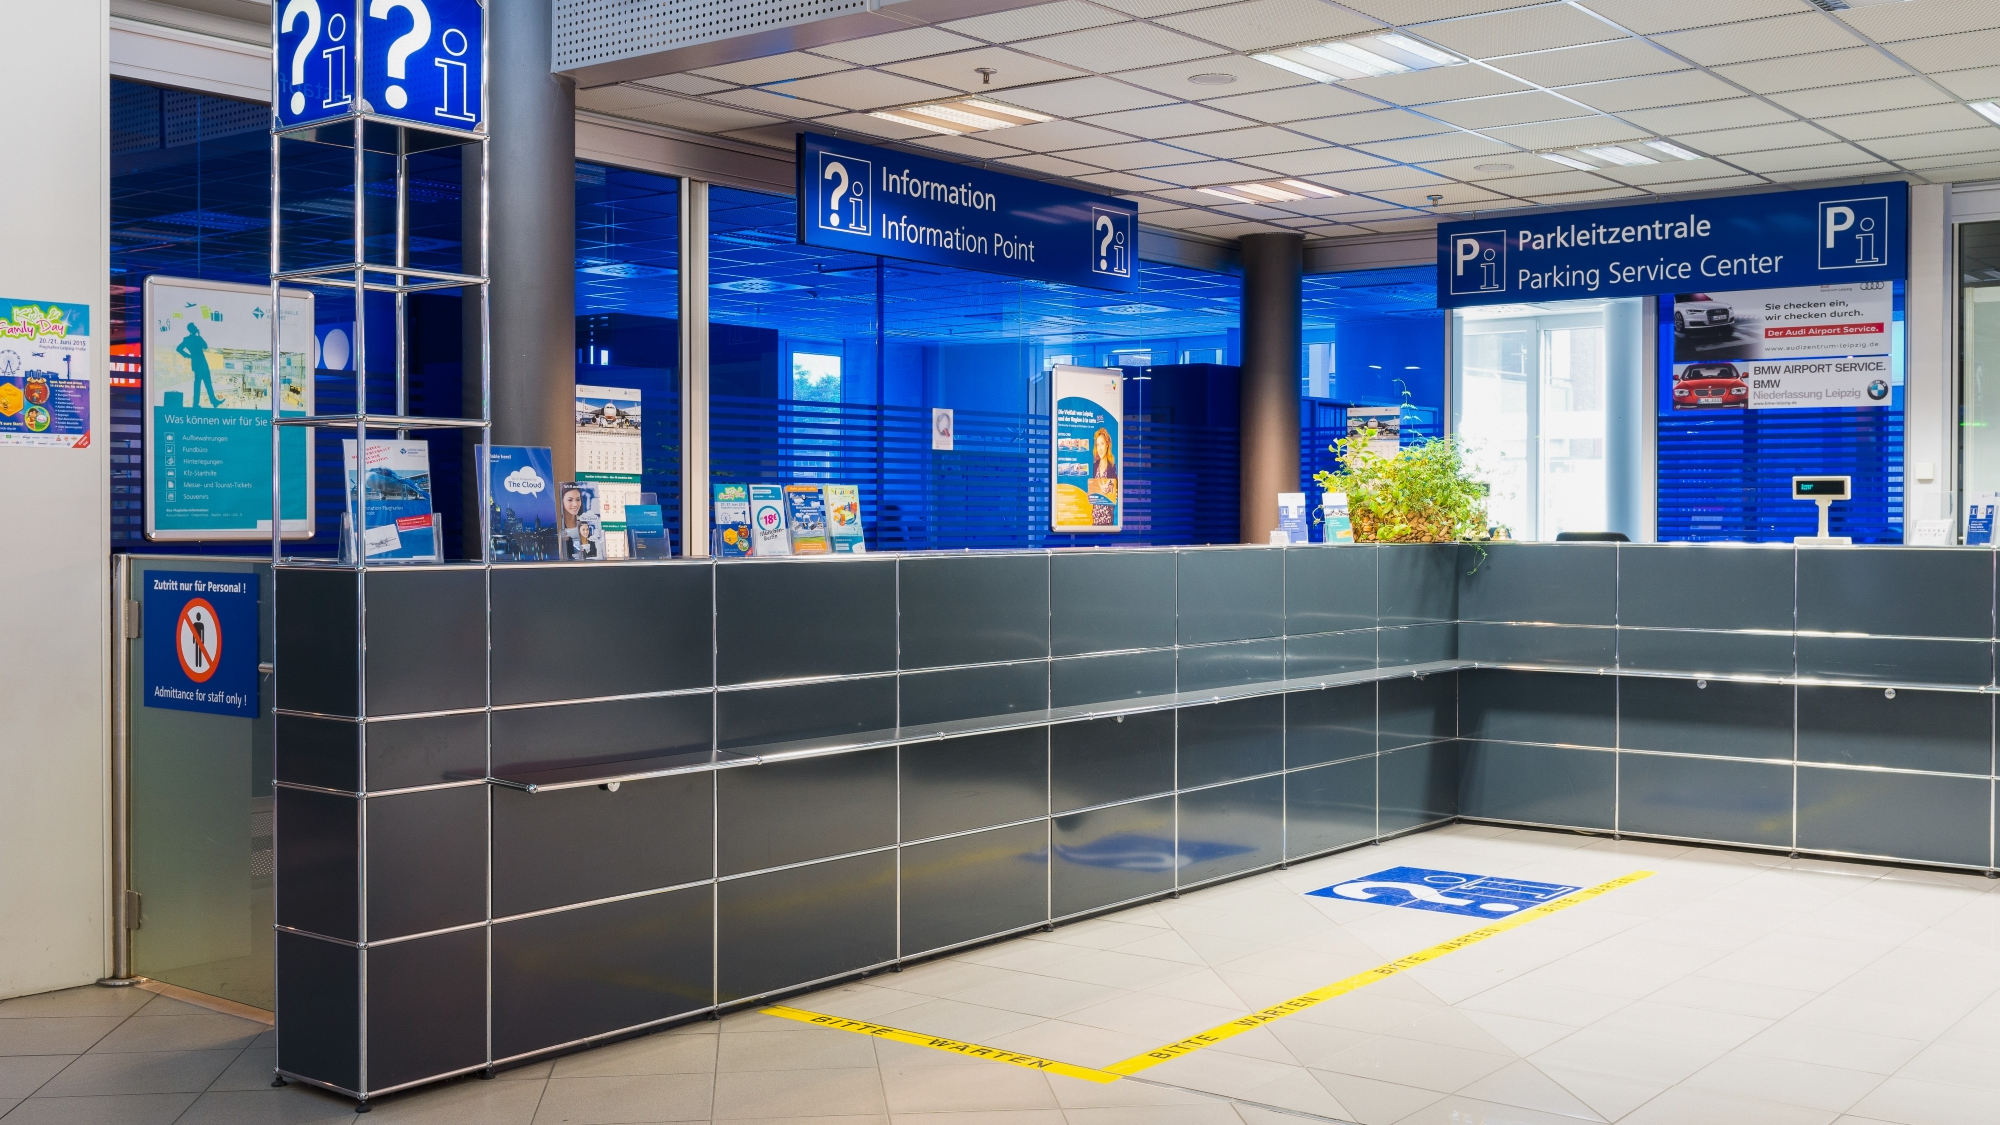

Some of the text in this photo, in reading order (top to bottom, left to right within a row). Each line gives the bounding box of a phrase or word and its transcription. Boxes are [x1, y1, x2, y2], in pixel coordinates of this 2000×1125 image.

[882, 167, 996, 212] Information
[882, 213, 1035, 262] Information Point
[1518, 214, 1711, 252] Parkleitzentrale
[1518, 254, 1784, 292] Parking Service Center
[1765, 299, 1849, 311] Sie checken ein,
[1765, 310, 1864, 321] wir checken durch.
[36, 319, 64, 336] Day
[1768, 325, 1879, 337] Der Audi Airport Service.
[59, 339, 72, 347] Juni
[1765, 342, 1879, 352] www.audizentrum-leipzig.de
[1753, 361, 1887, 376] BMW AIRPORT SERVICE.
[1753, 379, 1781, 389] BMW
[1753, 388, 1861, 401] Niederlassung Leipzig
[164, 415, 267, 427] Was können wir für Sie
[182, 435, 228, 443] Aufbewahrungen
[183, 458, 223, 466] Hinterlegungen
[215, 481, 252, 489] Tourist-Tickets
[508, 480, 542, 489] The Cloud
[154, 579, 178, 591] Zutritt
[180, 582, 193, 591] nur
[194, 580, 206, 592] für
[208, 581, 241, 593] Personal
[154, 685, 194, 701] Admittance
[196, 688, 206, 702] for
[208, 691, 224, 703] staff
[226, 693, 242, 709] only
[1537, 897, 1579, 912] BITTE
[1373, 927, 1500, 975] BITTE WARTEN
[1149, 996, 1319, 1060] BITTE WARTEN
[811, 1016, 1053, 1069] BITTE WARTEN
